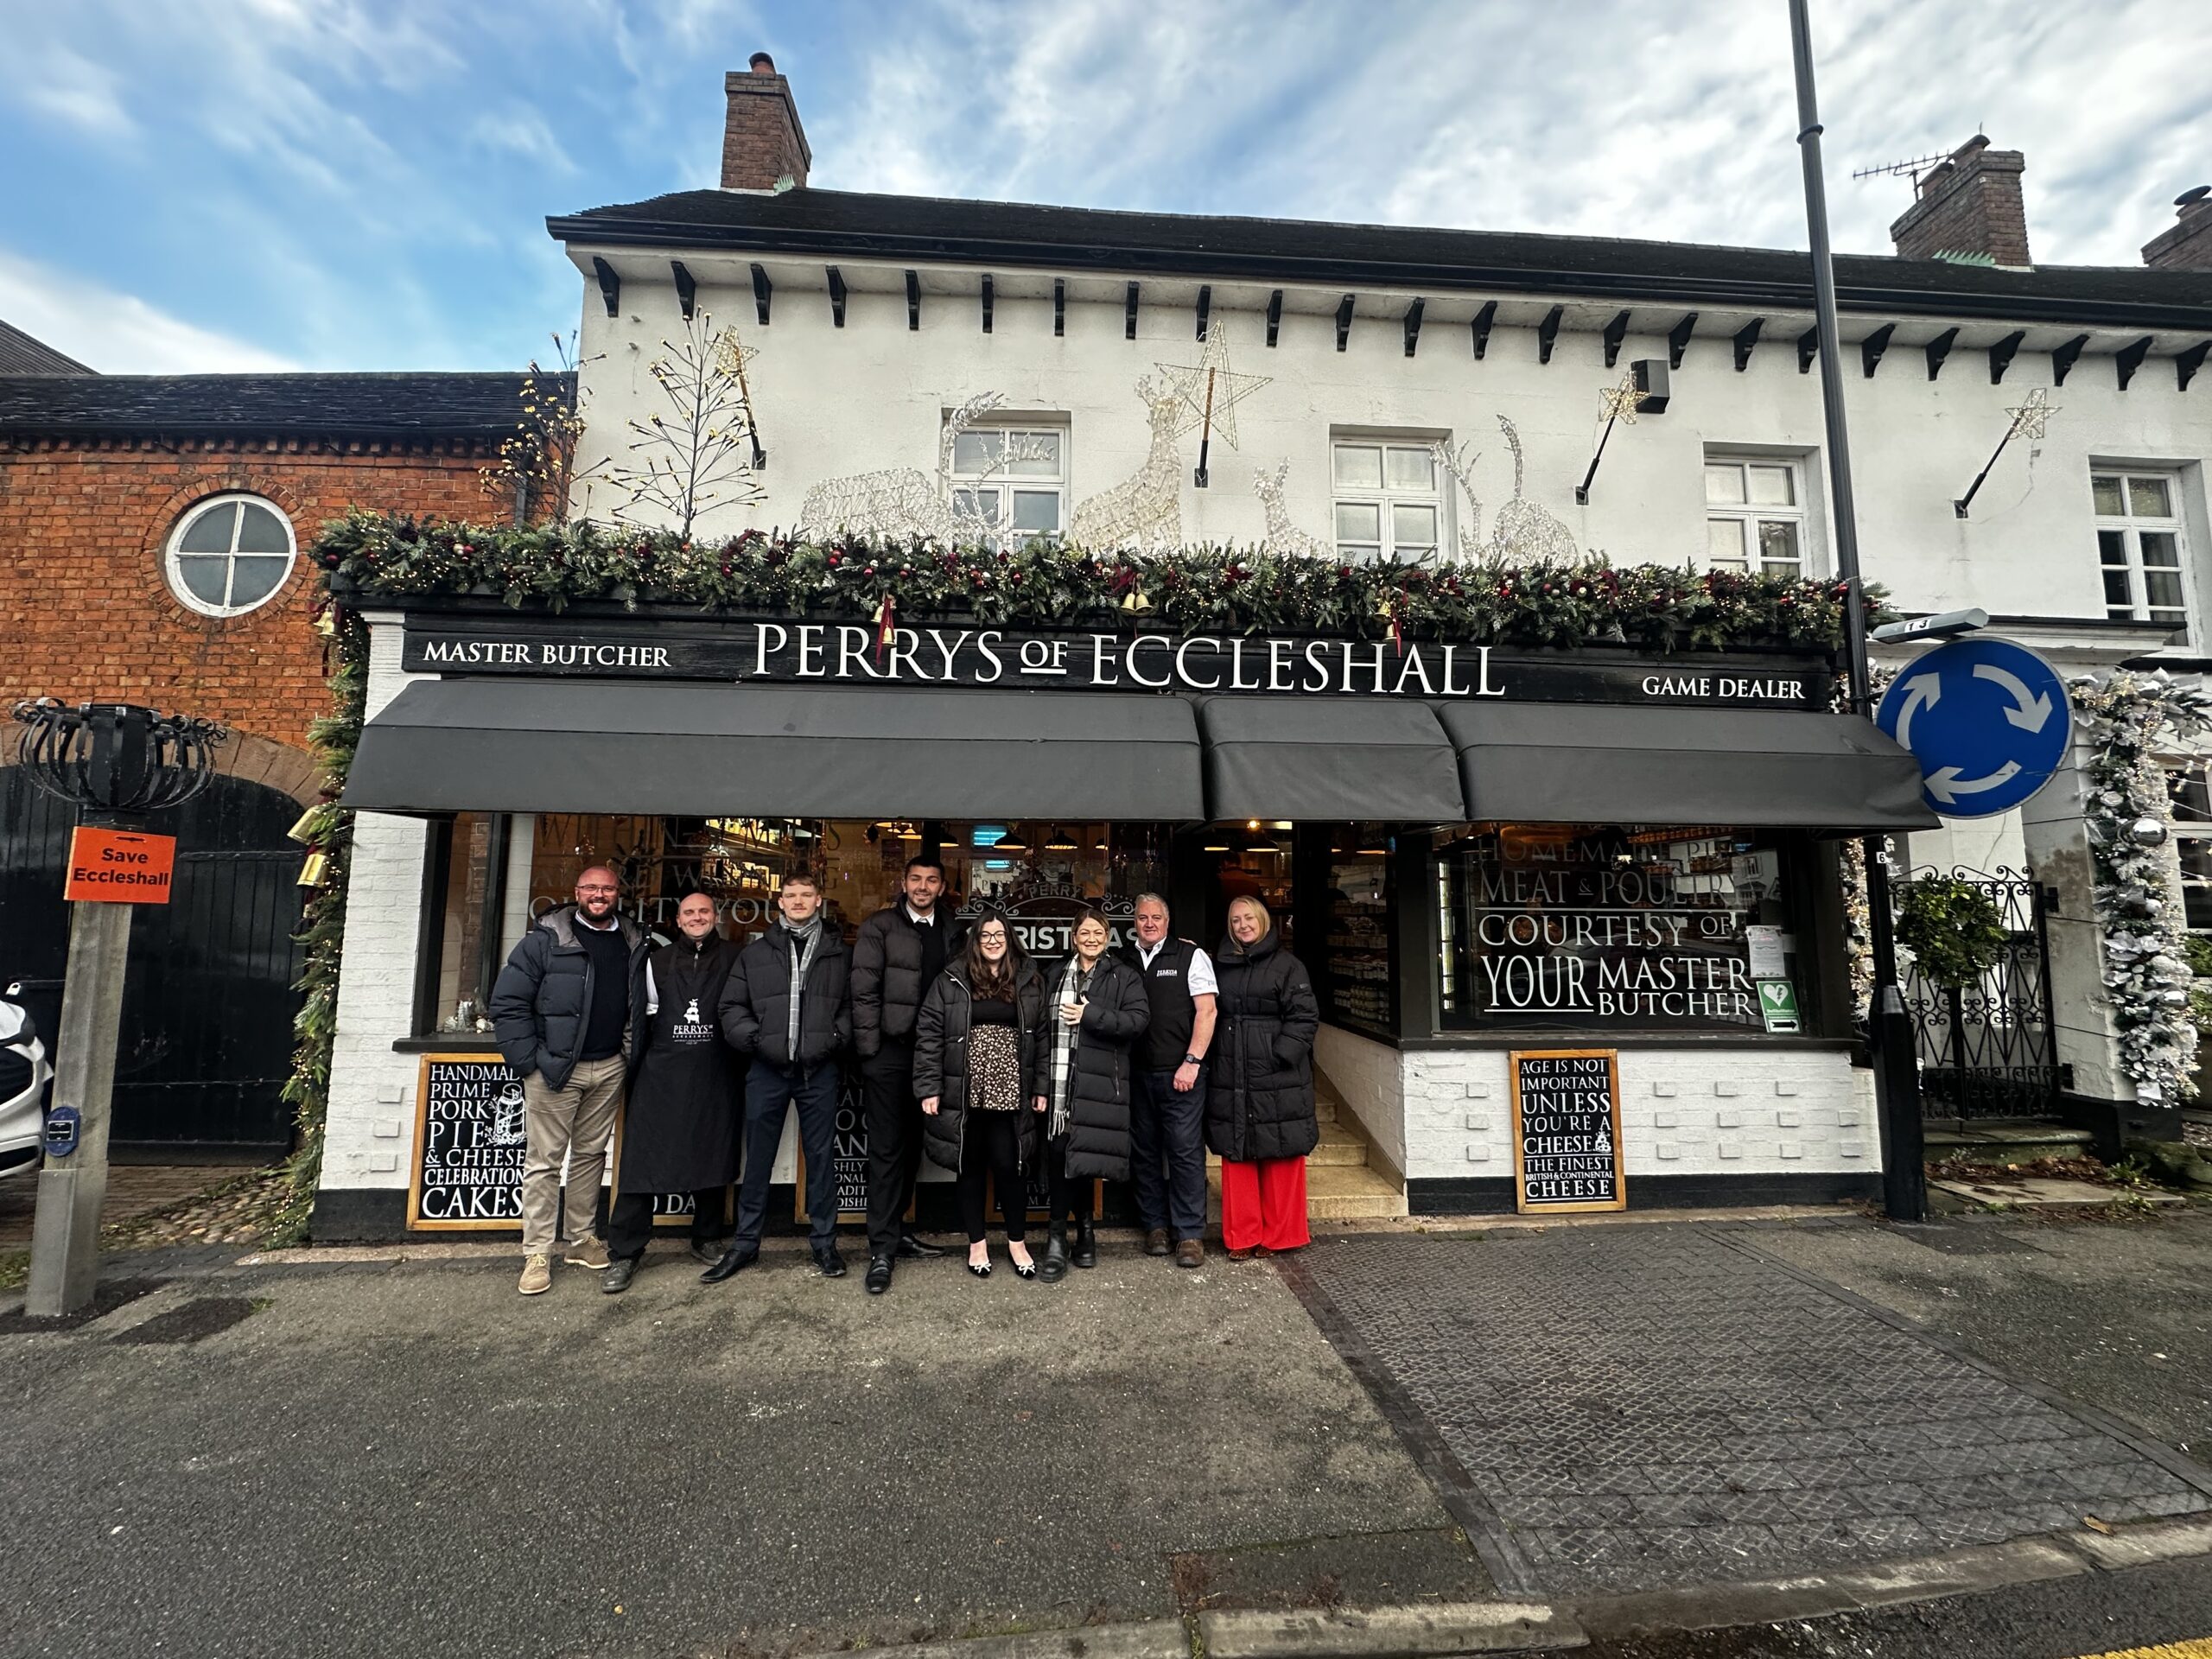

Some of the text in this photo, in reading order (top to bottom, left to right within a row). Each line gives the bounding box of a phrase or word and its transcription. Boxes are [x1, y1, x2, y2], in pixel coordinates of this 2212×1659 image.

[423, 641, 671, 667] MASTER BUTCHER
[753, 623, 1505, 696] PERRYS OF ECCLESHALL
[1643, 677, 1806, 699] GAME DEALER
[102, 848, 149, 863] Save
[73, 868, 168, 886] Eccleshall
[1479, 870, 1743, 906] MEAT & POULTRY
[1478, 914, 1731, 947] COURTESY OF
[1480, 955, 1755, 1007] YOUR MASTER
[1599, 992, 1755, 1016] BUTCHER
[674, 1025, 709, 1033] PERRYS
[1521, 1059, 1607, 1074] AGE IS NOT
[430, 1083, 490, 1098] PRIME
[1522, 1077, 1609, 1091] IMPORTANT
[429, 1100, 491, 1120] PORK
[1522, 1093, 1611, 1114] UNLESS
[1522, 1116, 1611, 1132] YOU'RE A
[428, 1122, 484, 1148] PIE
[426, 1149, 525, 1166] & CHEESE
[1524, 1157, 1611, 1173] THE FINEST
[424, 1168, 524, 1185] CELEBRATION
[1525, 1173, 1553, 1181] BRITISH
[1560, 1171, 1614, 1179] CONTINENTAL
[1526, 1180, 1610, 1198] CHEESE
[423, 1187, 523, 1217] CAKES
